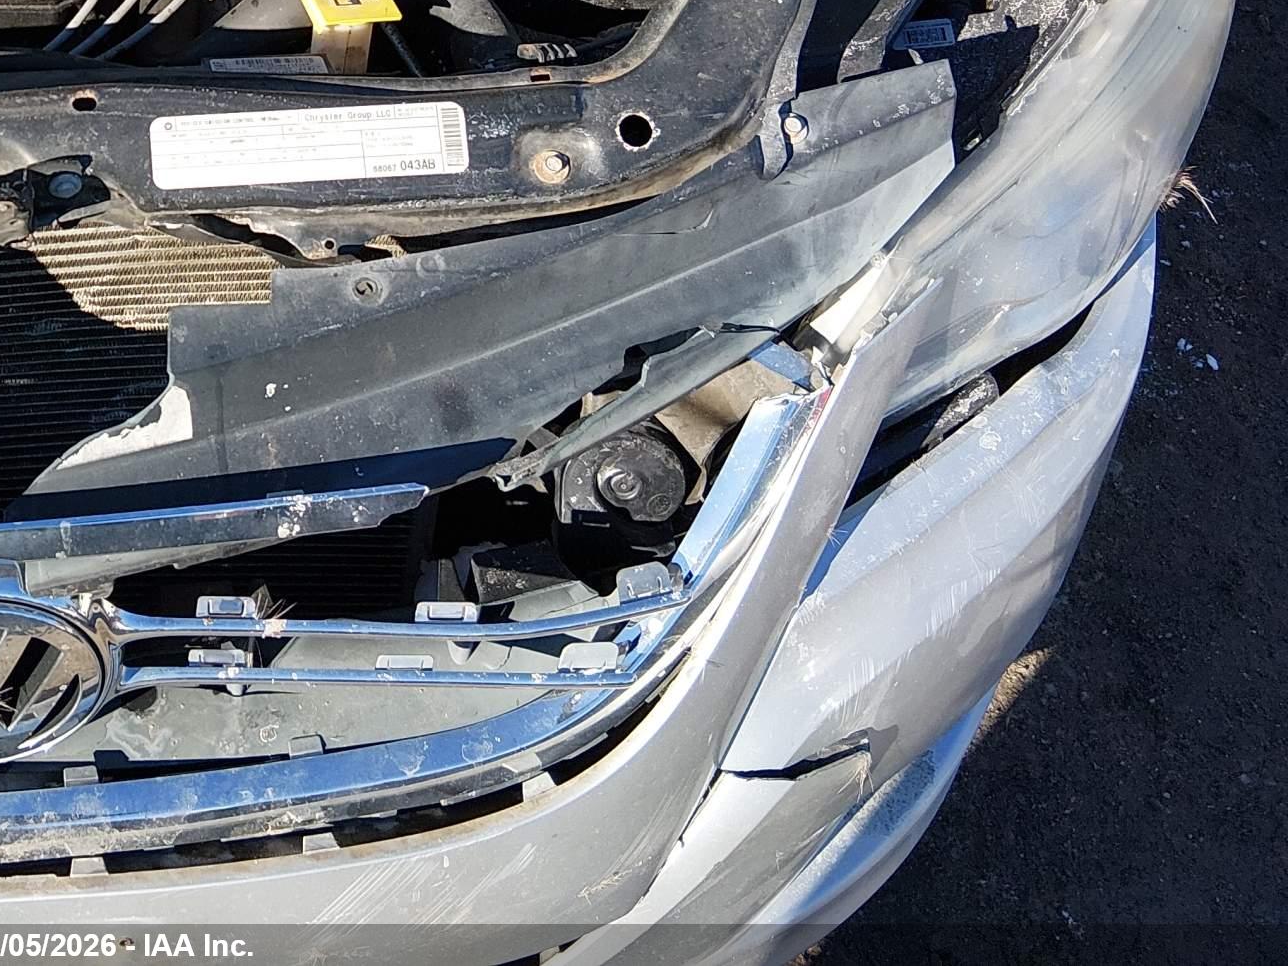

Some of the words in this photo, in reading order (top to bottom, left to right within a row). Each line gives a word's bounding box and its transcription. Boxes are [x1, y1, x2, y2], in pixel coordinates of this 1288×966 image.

[304, 112, 342, 123] Chrysler
[347, 109, 372, 120] Group
[376, 109, 391, 118] LLC
[399, 159, 436, 171] 043AB
